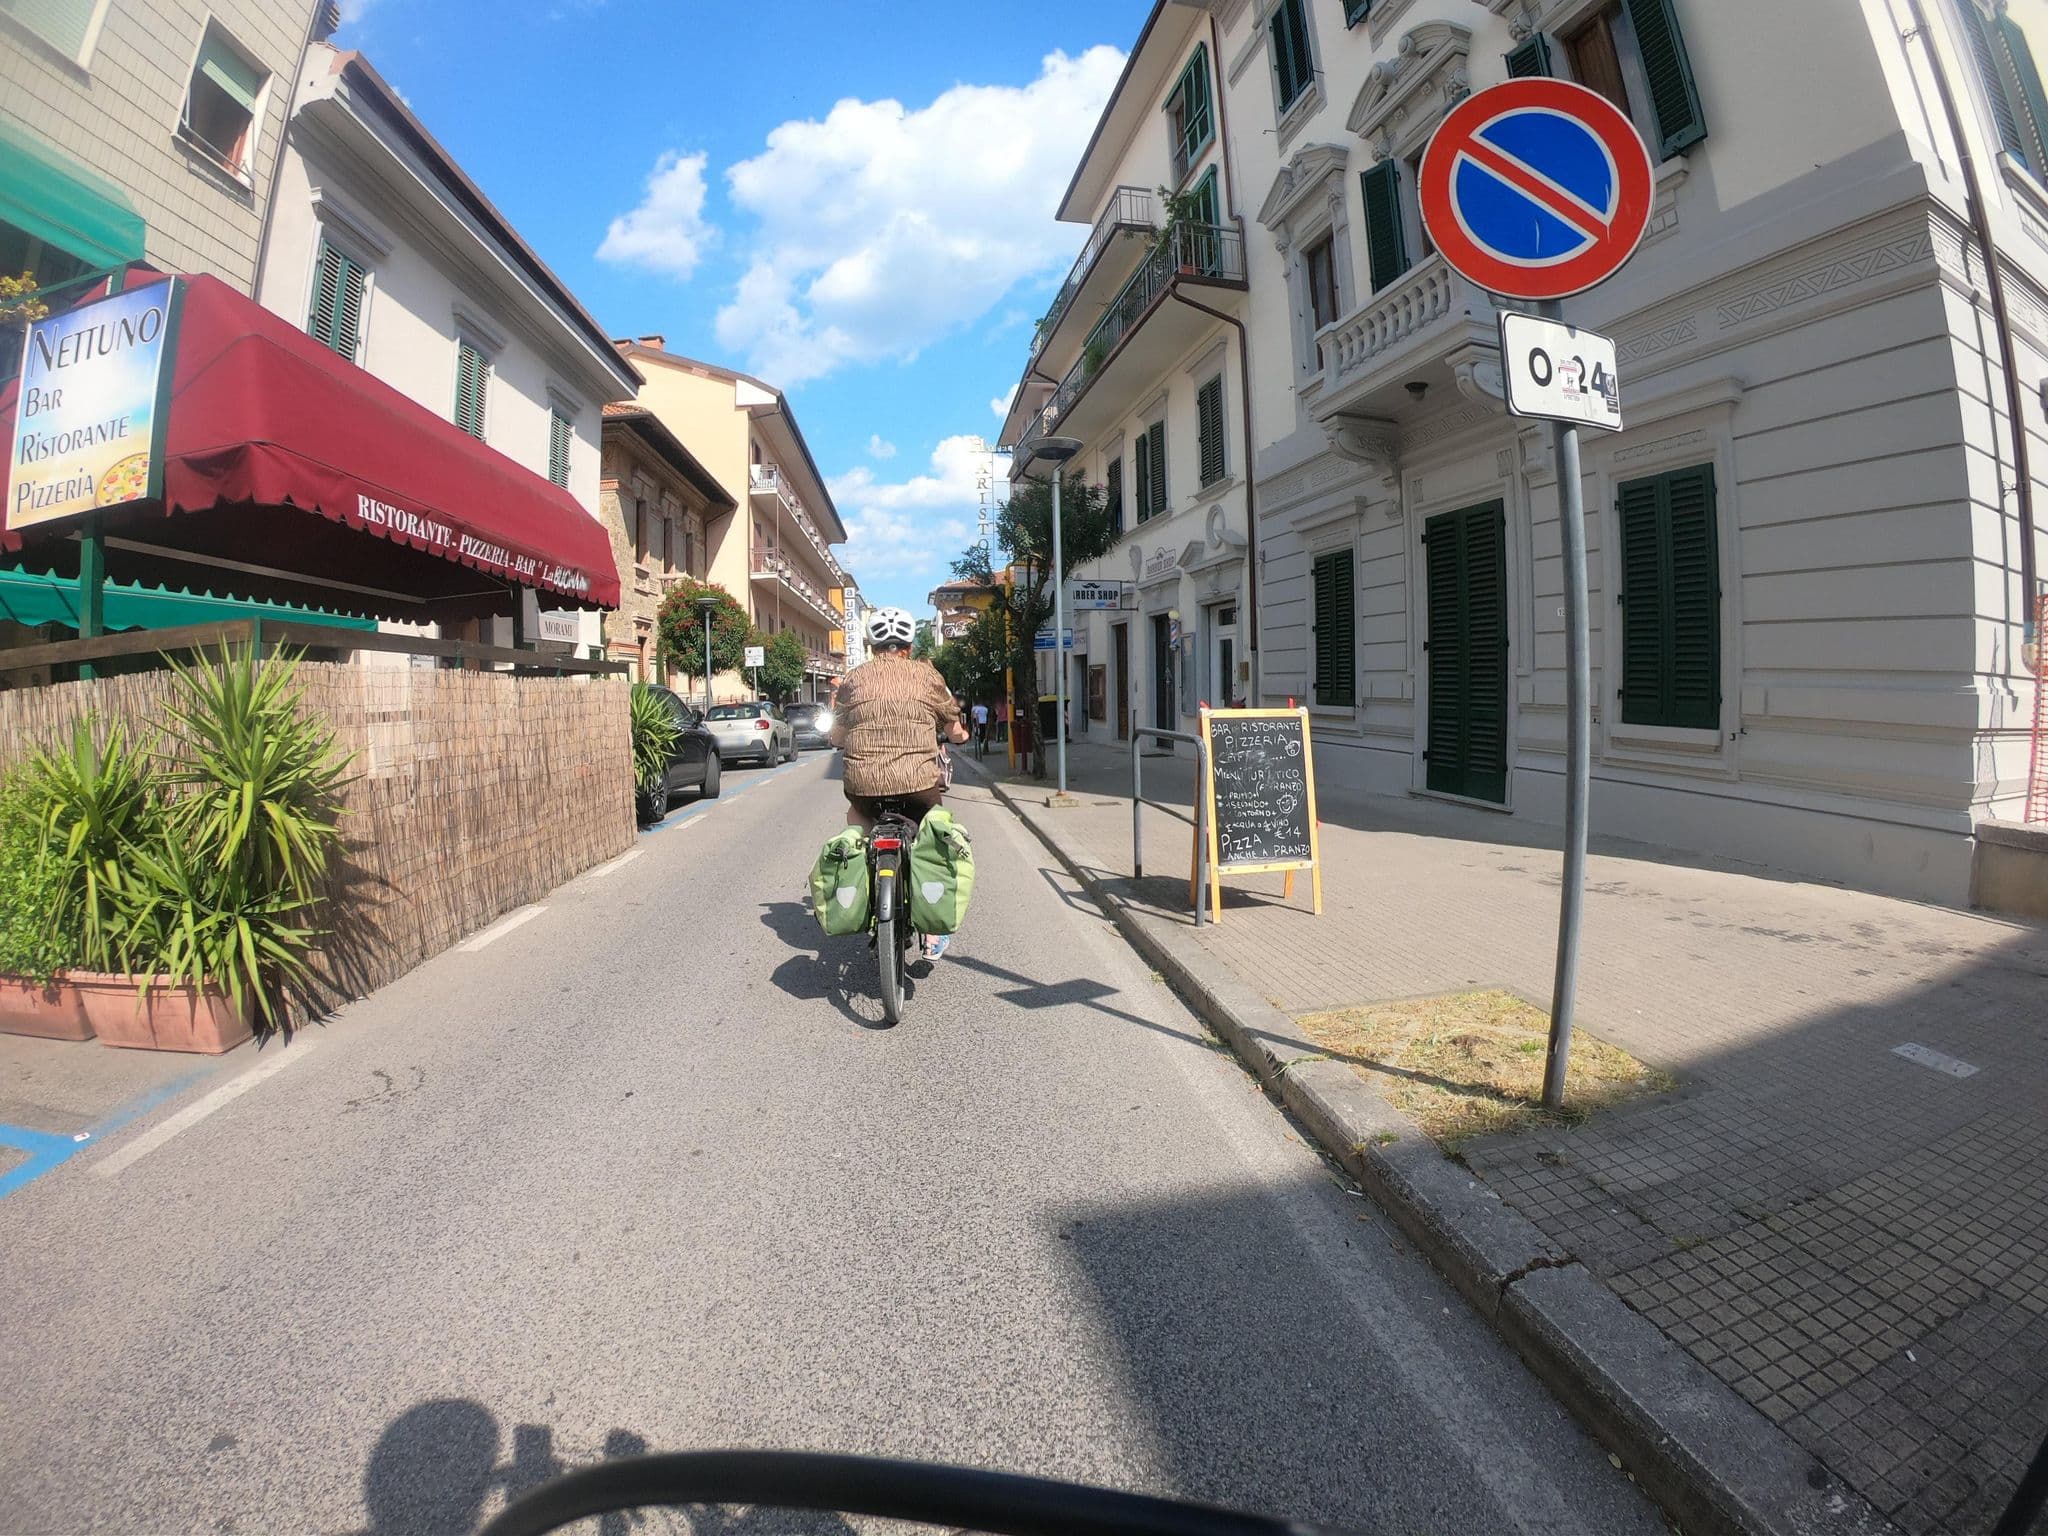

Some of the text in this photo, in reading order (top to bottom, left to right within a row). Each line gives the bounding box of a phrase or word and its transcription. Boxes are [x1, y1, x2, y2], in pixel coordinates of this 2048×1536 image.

[30, 307, 162, 378] NETTUNO
[1528, 347, 1552, 387] 0
[25, 387, 63, 418] BAR
[357, 493, 452, 547] RISTORANTE
[459, 534, 509, 567] PIZZERIA
[515, 554, 536, 576] BAR
[1097, 590, 1118, 600] SHOP
[846, 589, 855, 668] augustu
[1211, 721, 1301, 737] BAR RISTORANTE
[1225, 734, 1288, 750] PIZZERIA
[1221, 833, 1262, 852] PIZZA
[1227, 844, 1309, 861] ANCHE A PRANZO
